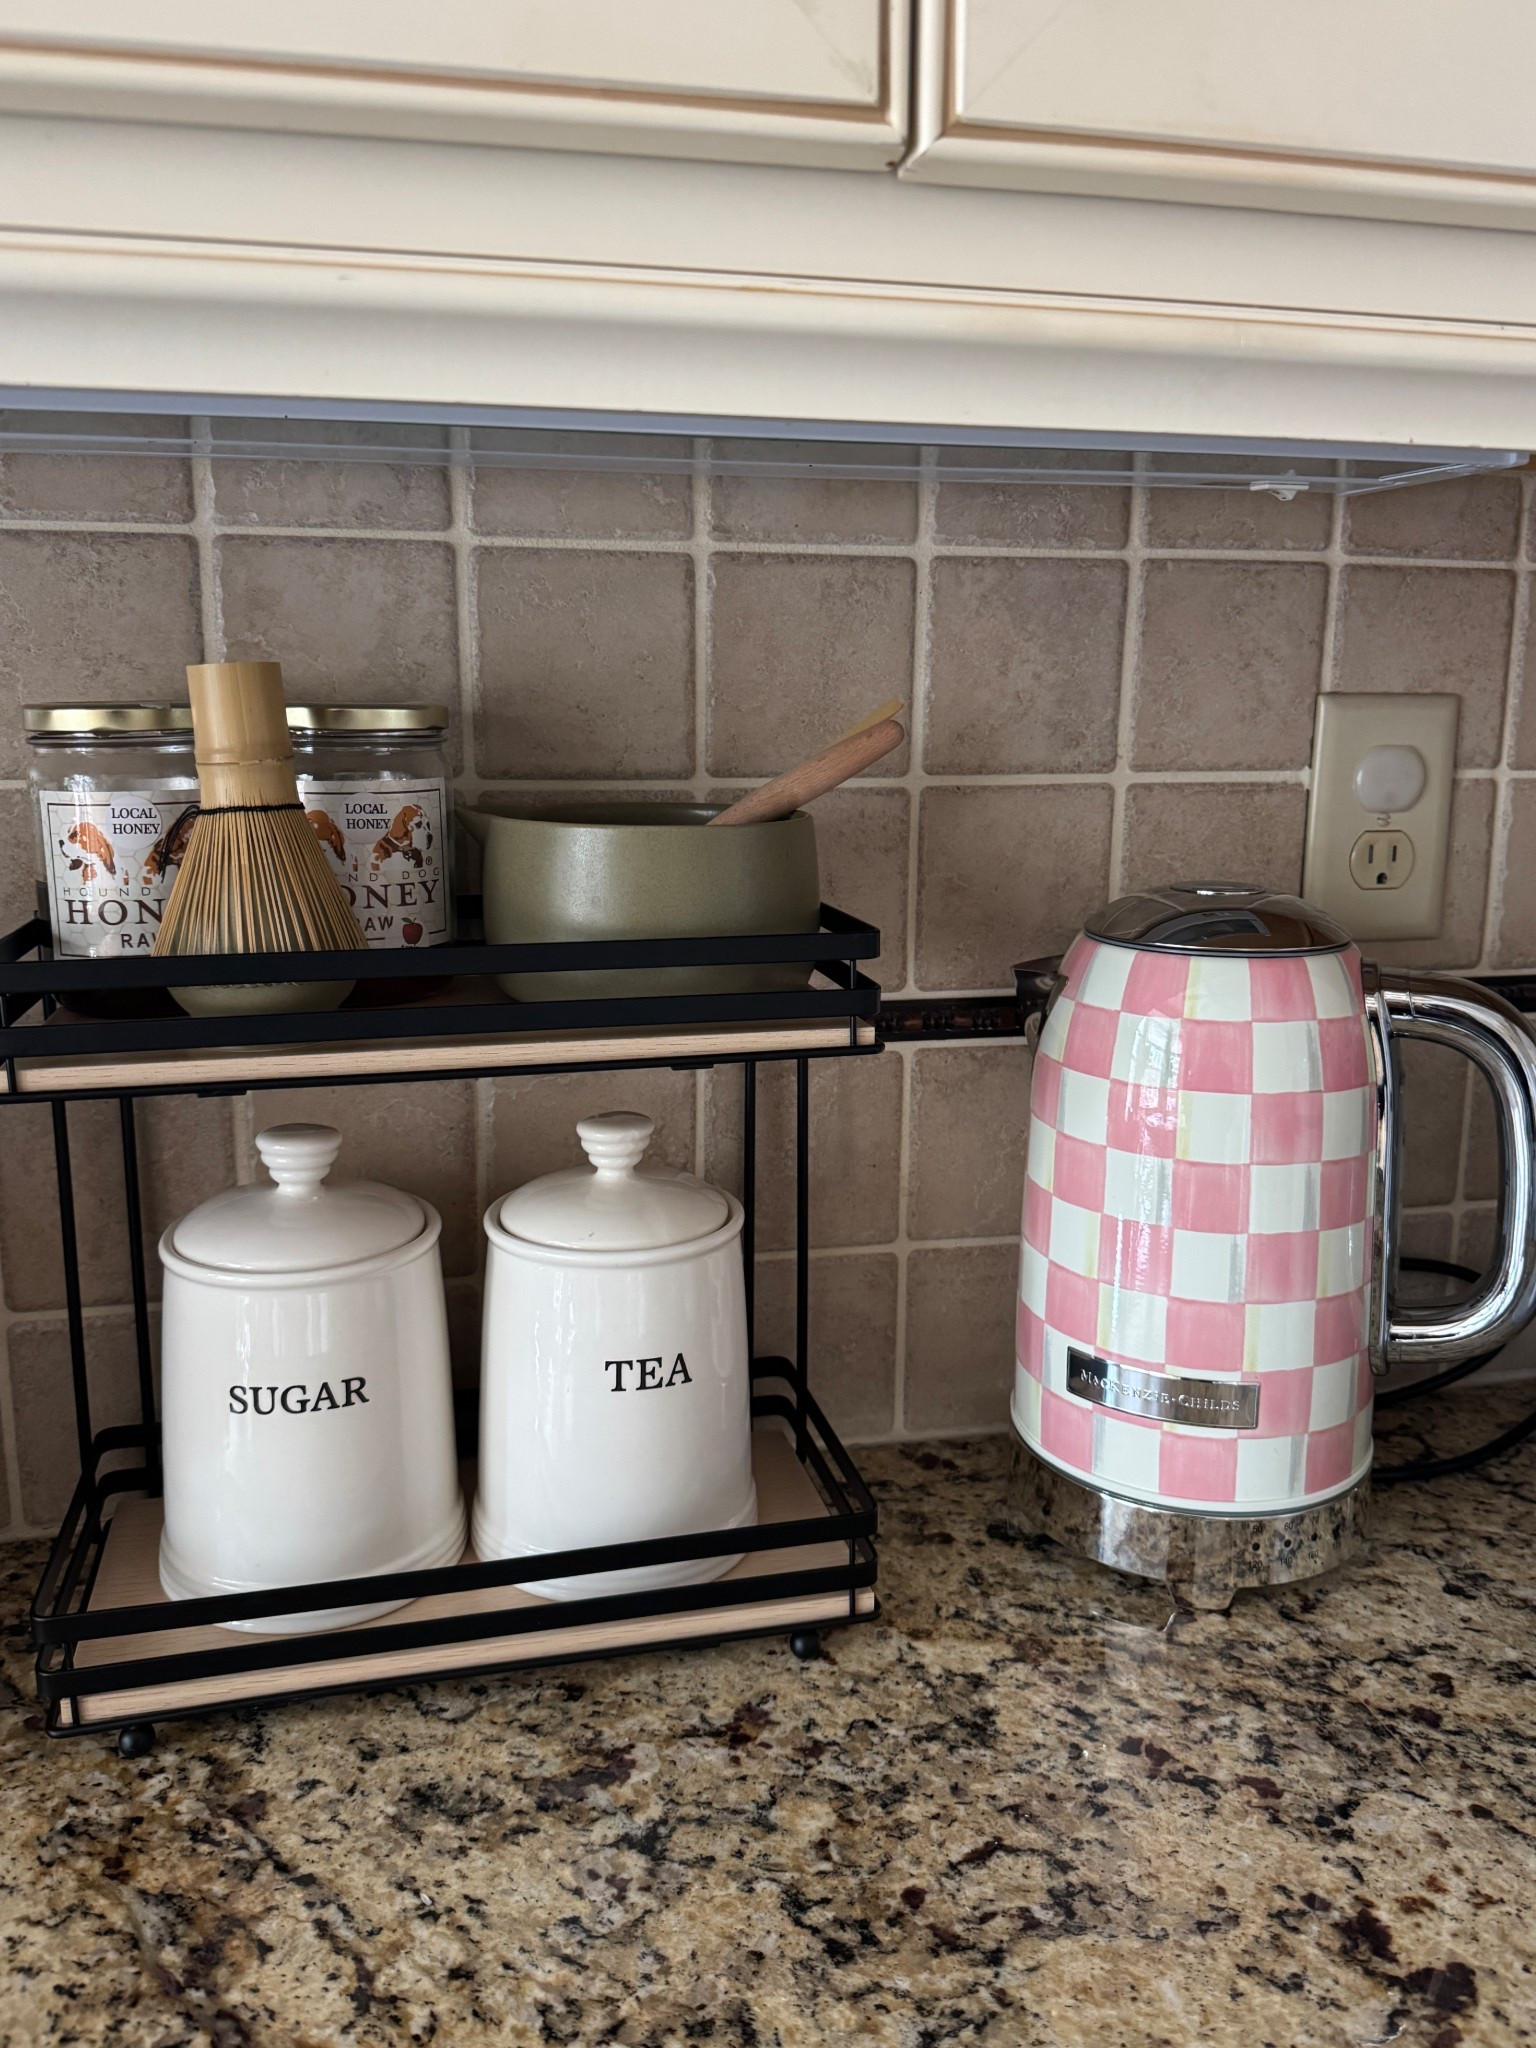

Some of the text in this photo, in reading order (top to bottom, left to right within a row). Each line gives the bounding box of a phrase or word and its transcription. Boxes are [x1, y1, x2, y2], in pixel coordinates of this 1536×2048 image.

[111, 807, 157, 819] LOCAL
[345, 803, 388, 815] LOCAL
[113, 823, 160, 835] HONEY
[346, 818, 391, 830] HONEY
[402, 867, 440, 880] DOG
[64, 899, 167, 925] HON
[357, 915, 394, 932] AW
[120, 933, 157, 949] RA
[604, 1352, 693, 1393] TEA
[229, 1376, 370, 1415] SUGAR
